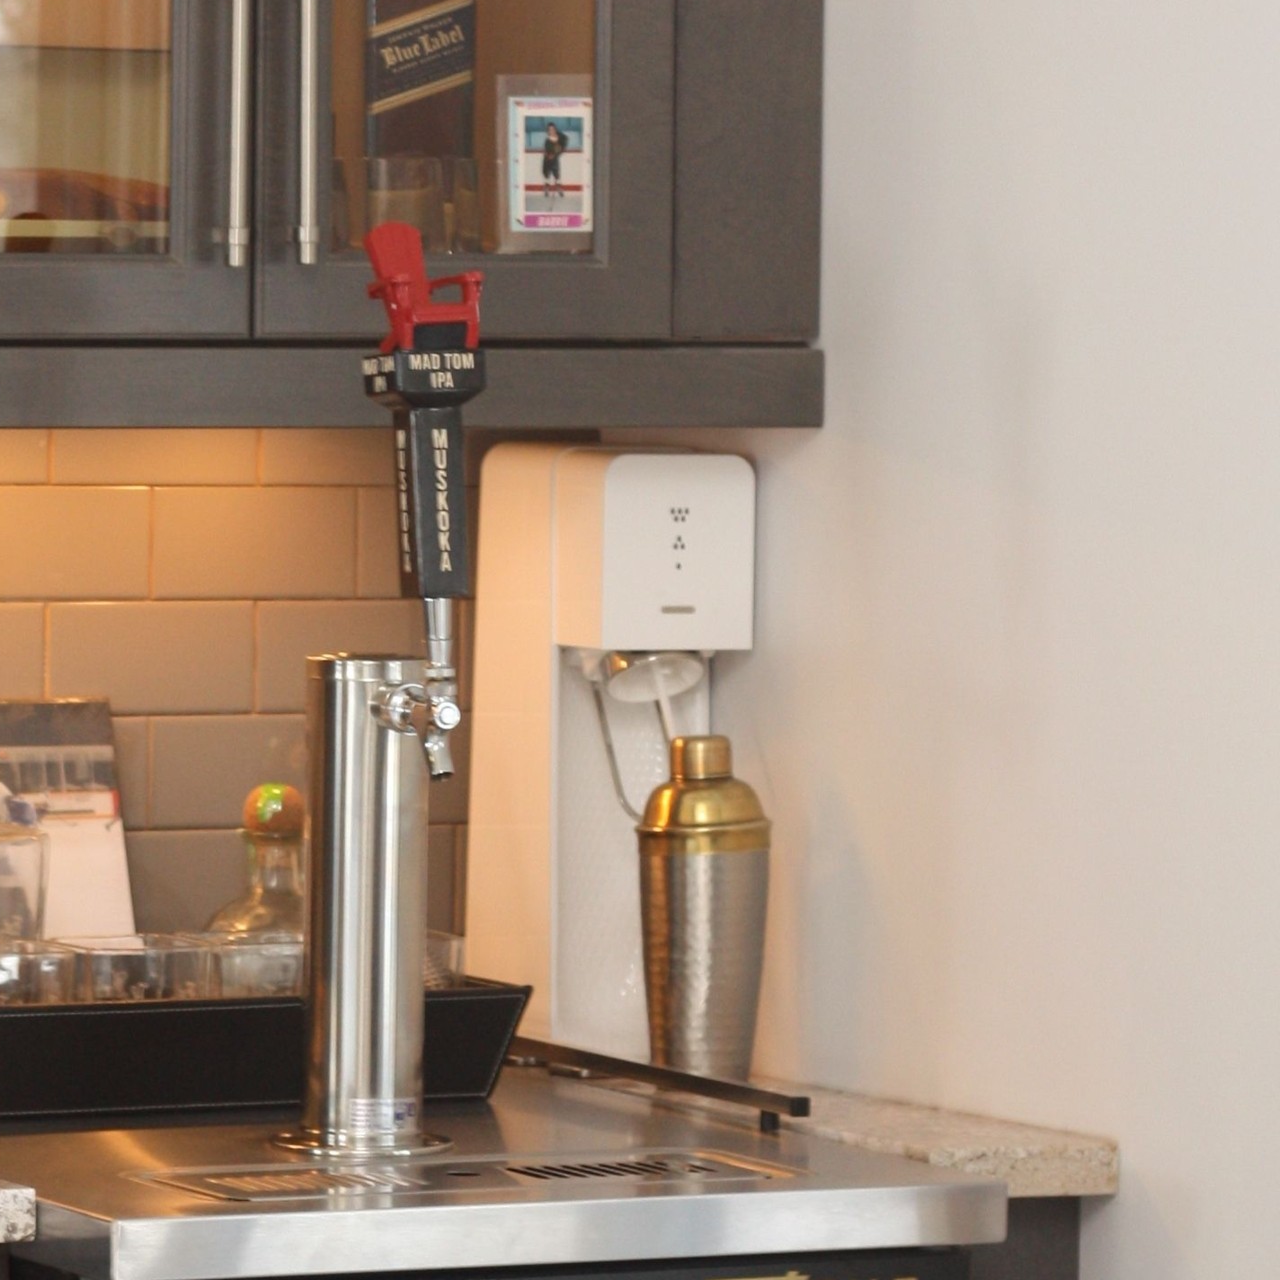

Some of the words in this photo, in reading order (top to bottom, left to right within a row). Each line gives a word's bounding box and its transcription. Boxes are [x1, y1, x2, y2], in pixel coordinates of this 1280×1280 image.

[380, 43, 421, 69] Blue
[419, 24, 465, 56] Label
[408, 353, 441, 370] MAD
[443, 353, 475, 369] TOM
[430, 371, 455, 388] IPA
[431, 428, 453, 572] MUSKOKA
